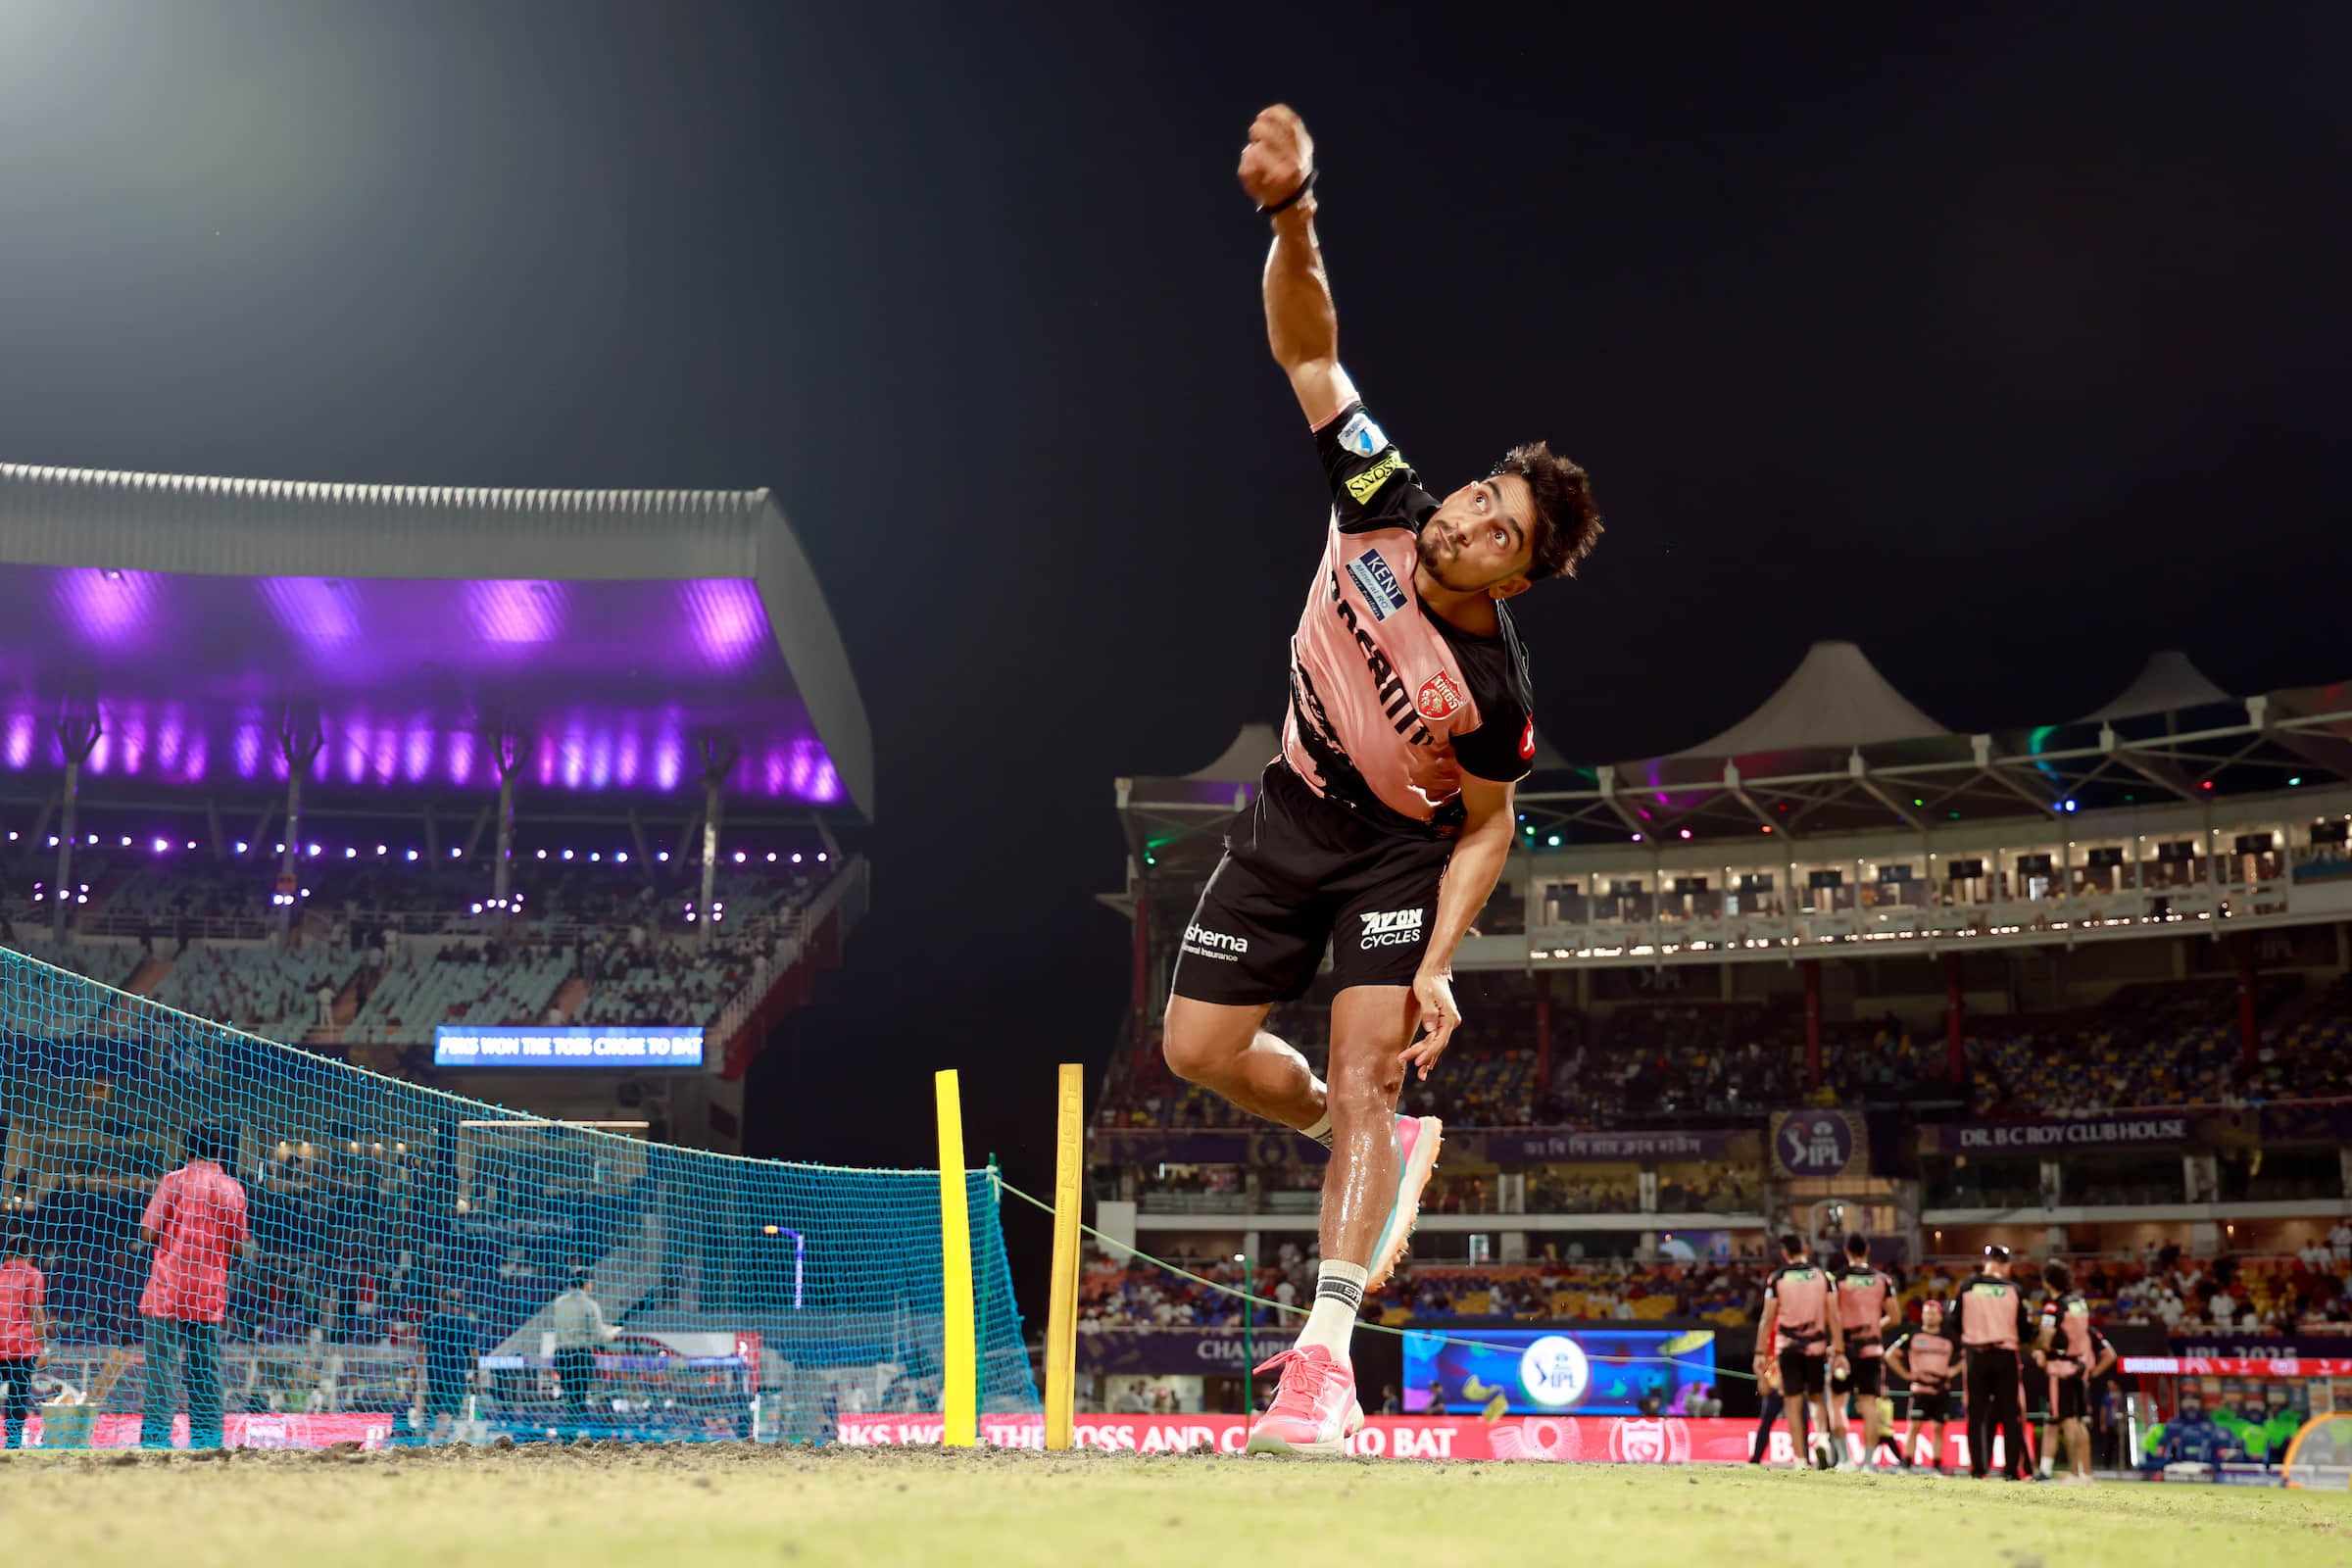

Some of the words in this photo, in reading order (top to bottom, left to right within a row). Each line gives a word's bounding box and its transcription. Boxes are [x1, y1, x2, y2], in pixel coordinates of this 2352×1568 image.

[1354, 564, 1379, 597] Mineral
[1367, 556, 1401, 602] KENT
[1432, 675, 1460, 710] KINGS
[1359, 907, 1423, 936] AVON
[1360, 928, 1421, 950] CYCLES
[480, 1037, 519, 1054] WON
[522, 1037, 551, 1054] THE
[554, 1037, 592, 1054] TOSS
[594, 1037, 645, 1054] CHOSE
[648, 1037, 670, 1054] TO
[672, 1037, 703, 1054] BAT
[1994, 1128, 2007, 1145] B
[2009, 1127, 2024, 1145] C
[2026, 1125, 2065, 1144] ROY
[2067, 1122, 2117, 1143] CLUB
[2119, 1119, 2186, 1140] HOUSE
[1808, 1145, 1845, 1167] IPL
[1073, 1425, 1137, 1452] OSS
[1140, 1426, 1215, 1454] AND
[1393, 1428, 1458, 1458] BAT
